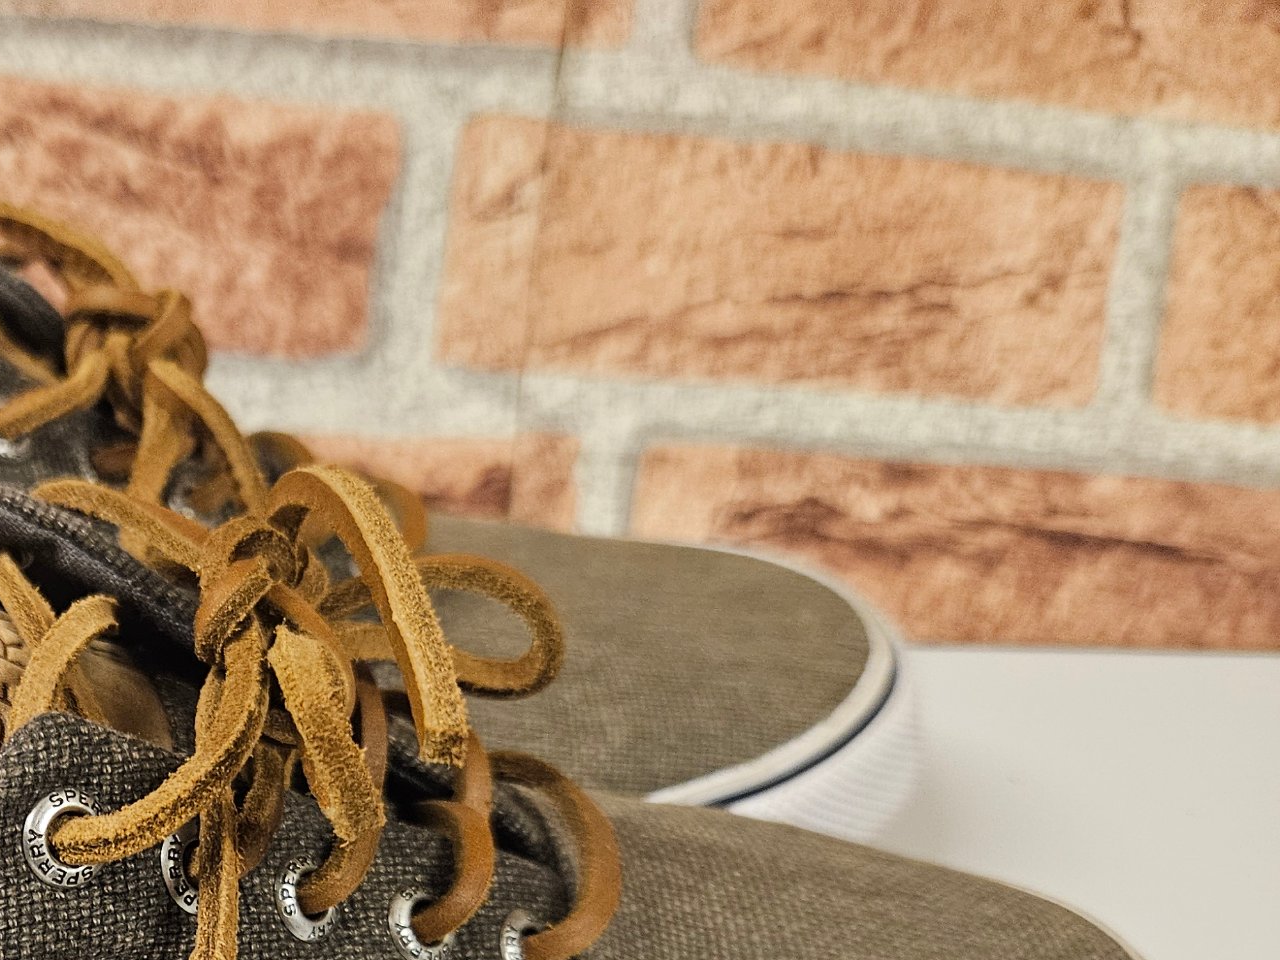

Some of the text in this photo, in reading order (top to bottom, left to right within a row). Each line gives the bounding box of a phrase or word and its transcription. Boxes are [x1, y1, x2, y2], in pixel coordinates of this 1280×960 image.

[49, 788, 104, 817] SPER
[27, 828, 94, 887] SPERRY
[167, 834, 200, 911] PERRY
